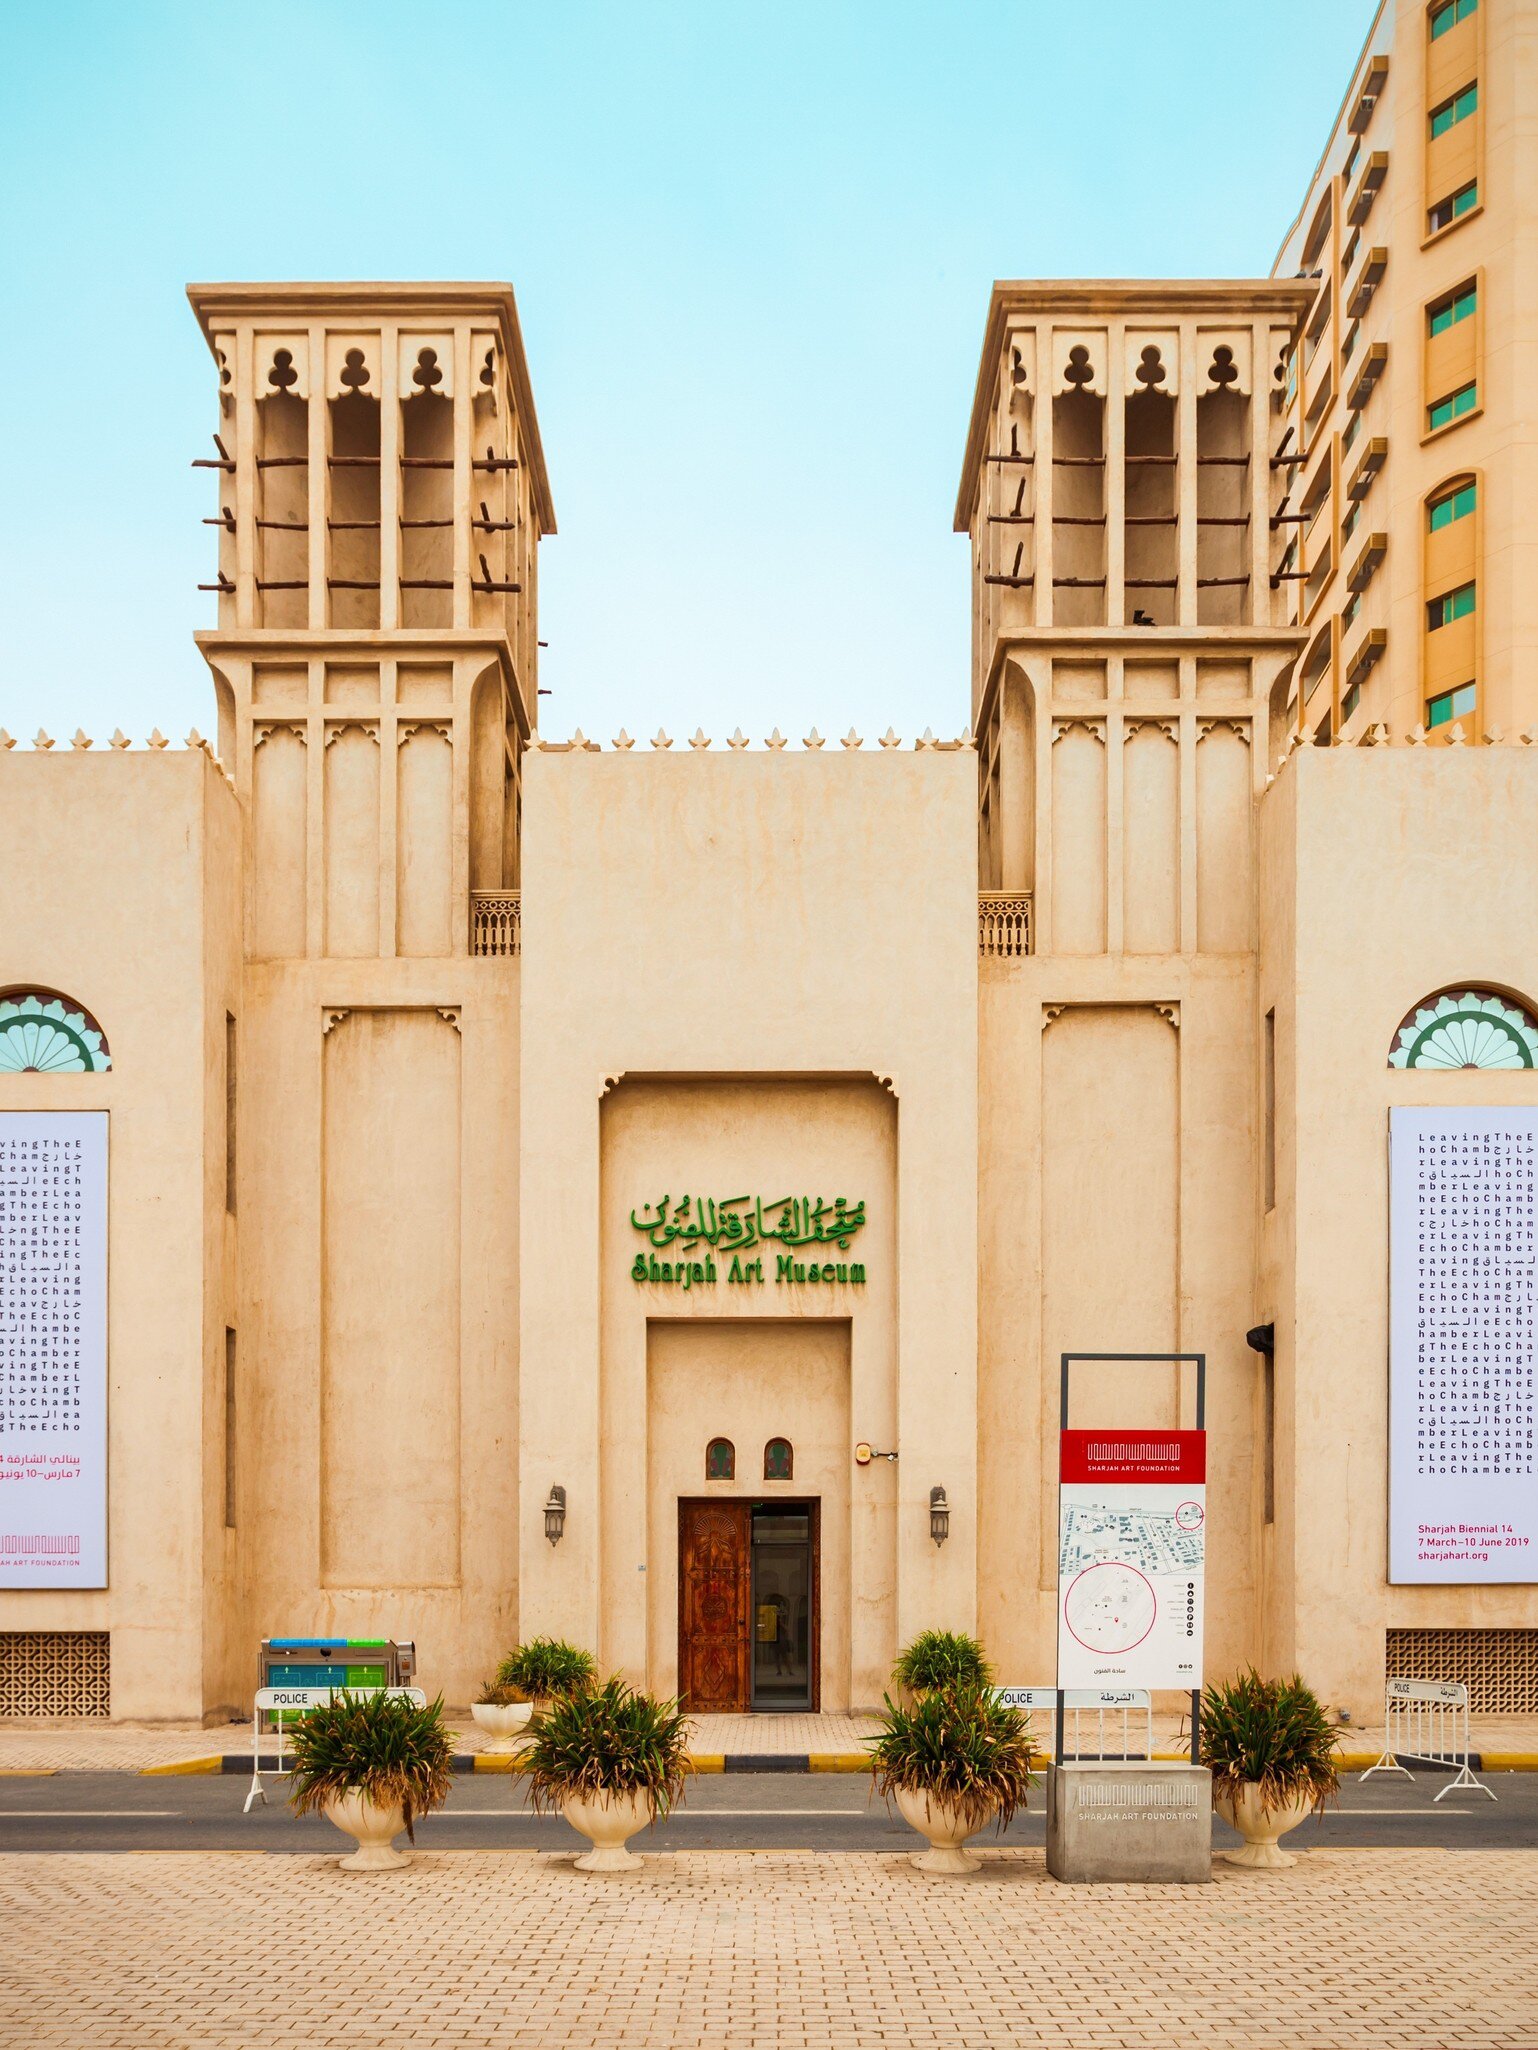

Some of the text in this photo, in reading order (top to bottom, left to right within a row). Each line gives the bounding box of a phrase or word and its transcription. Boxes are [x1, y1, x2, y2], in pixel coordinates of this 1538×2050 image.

[631, 1253, 866, 1290] Sharjah Art Museum
[7, 1454, 46, 1466] الشارقة
[50, 1454, 80, 1466] بينالي
[75, 1469, 80, 1478] 7
[1418, 1524, 1513, 1535] Sharjah Biennial 14
[1418, 1538, 1424, 1546] 7
[1479, 1538, 1502, 1546] June
[1505, 1538, 1529, 1546] 2019
[1418, 1551, 1488, 1562] sharjahart.org
[1394, 1683, 1410, 1694] POLICE
[273, 1693, 308, 1704] POLICE
[1100, 1692, 1135, 1704] الشرطة
[1079, 1812, 1198, 1821] SHARJAH ART FOUNDATION
